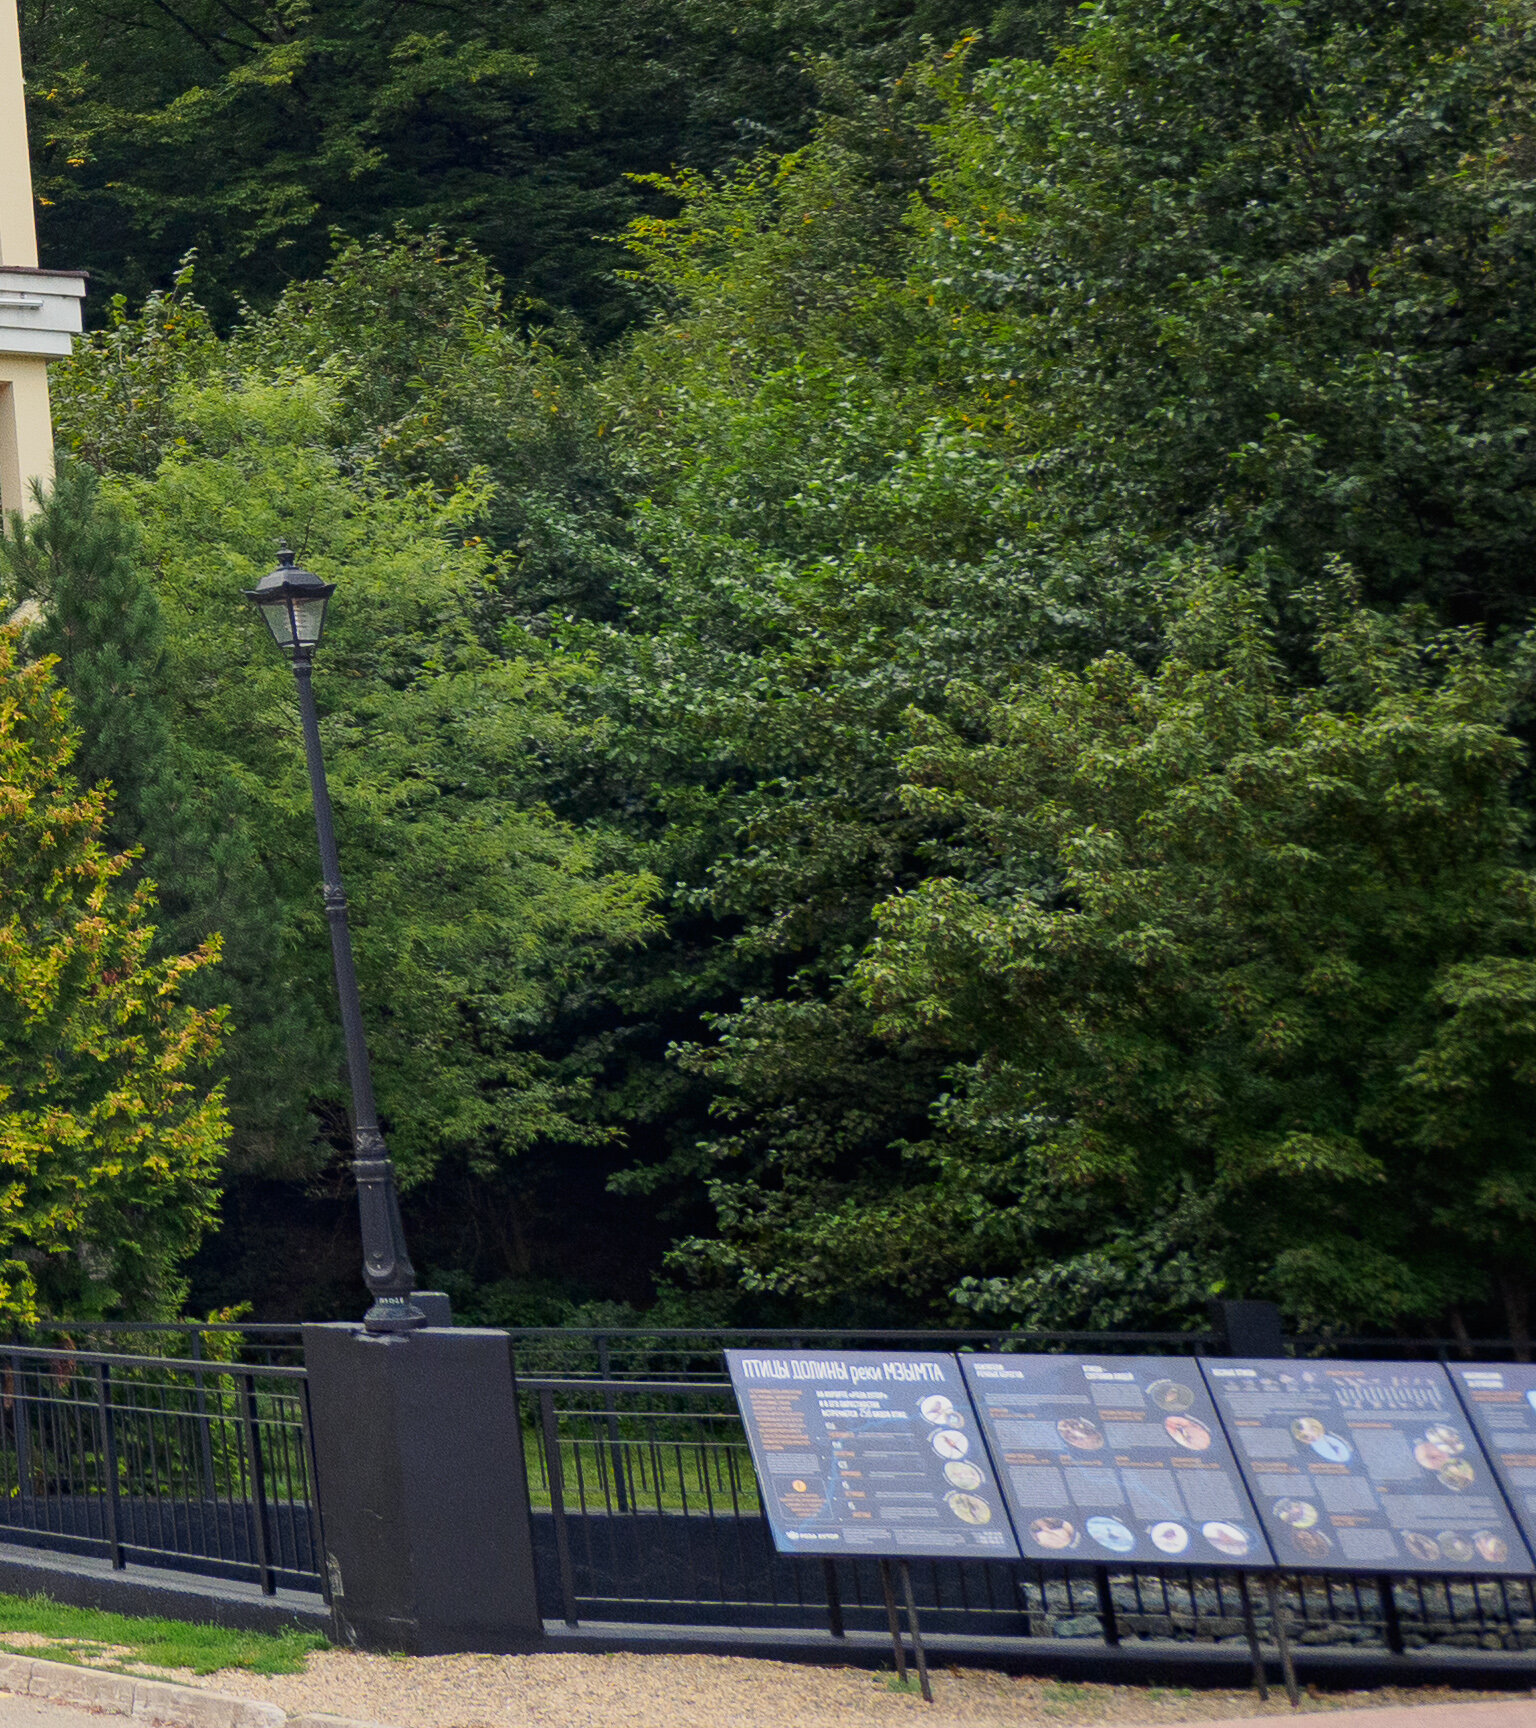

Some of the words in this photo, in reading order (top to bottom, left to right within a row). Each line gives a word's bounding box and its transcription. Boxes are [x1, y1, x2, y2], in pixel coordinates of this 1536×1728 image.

[741, 1359, 790, 1379] ПТИЦЫ
[790, 1360, 849, 1381] ДОЛИНЫ
[849, 1365, 883, 1385] реки
[882, 1362, 946, 1382] МЗЫМТА
